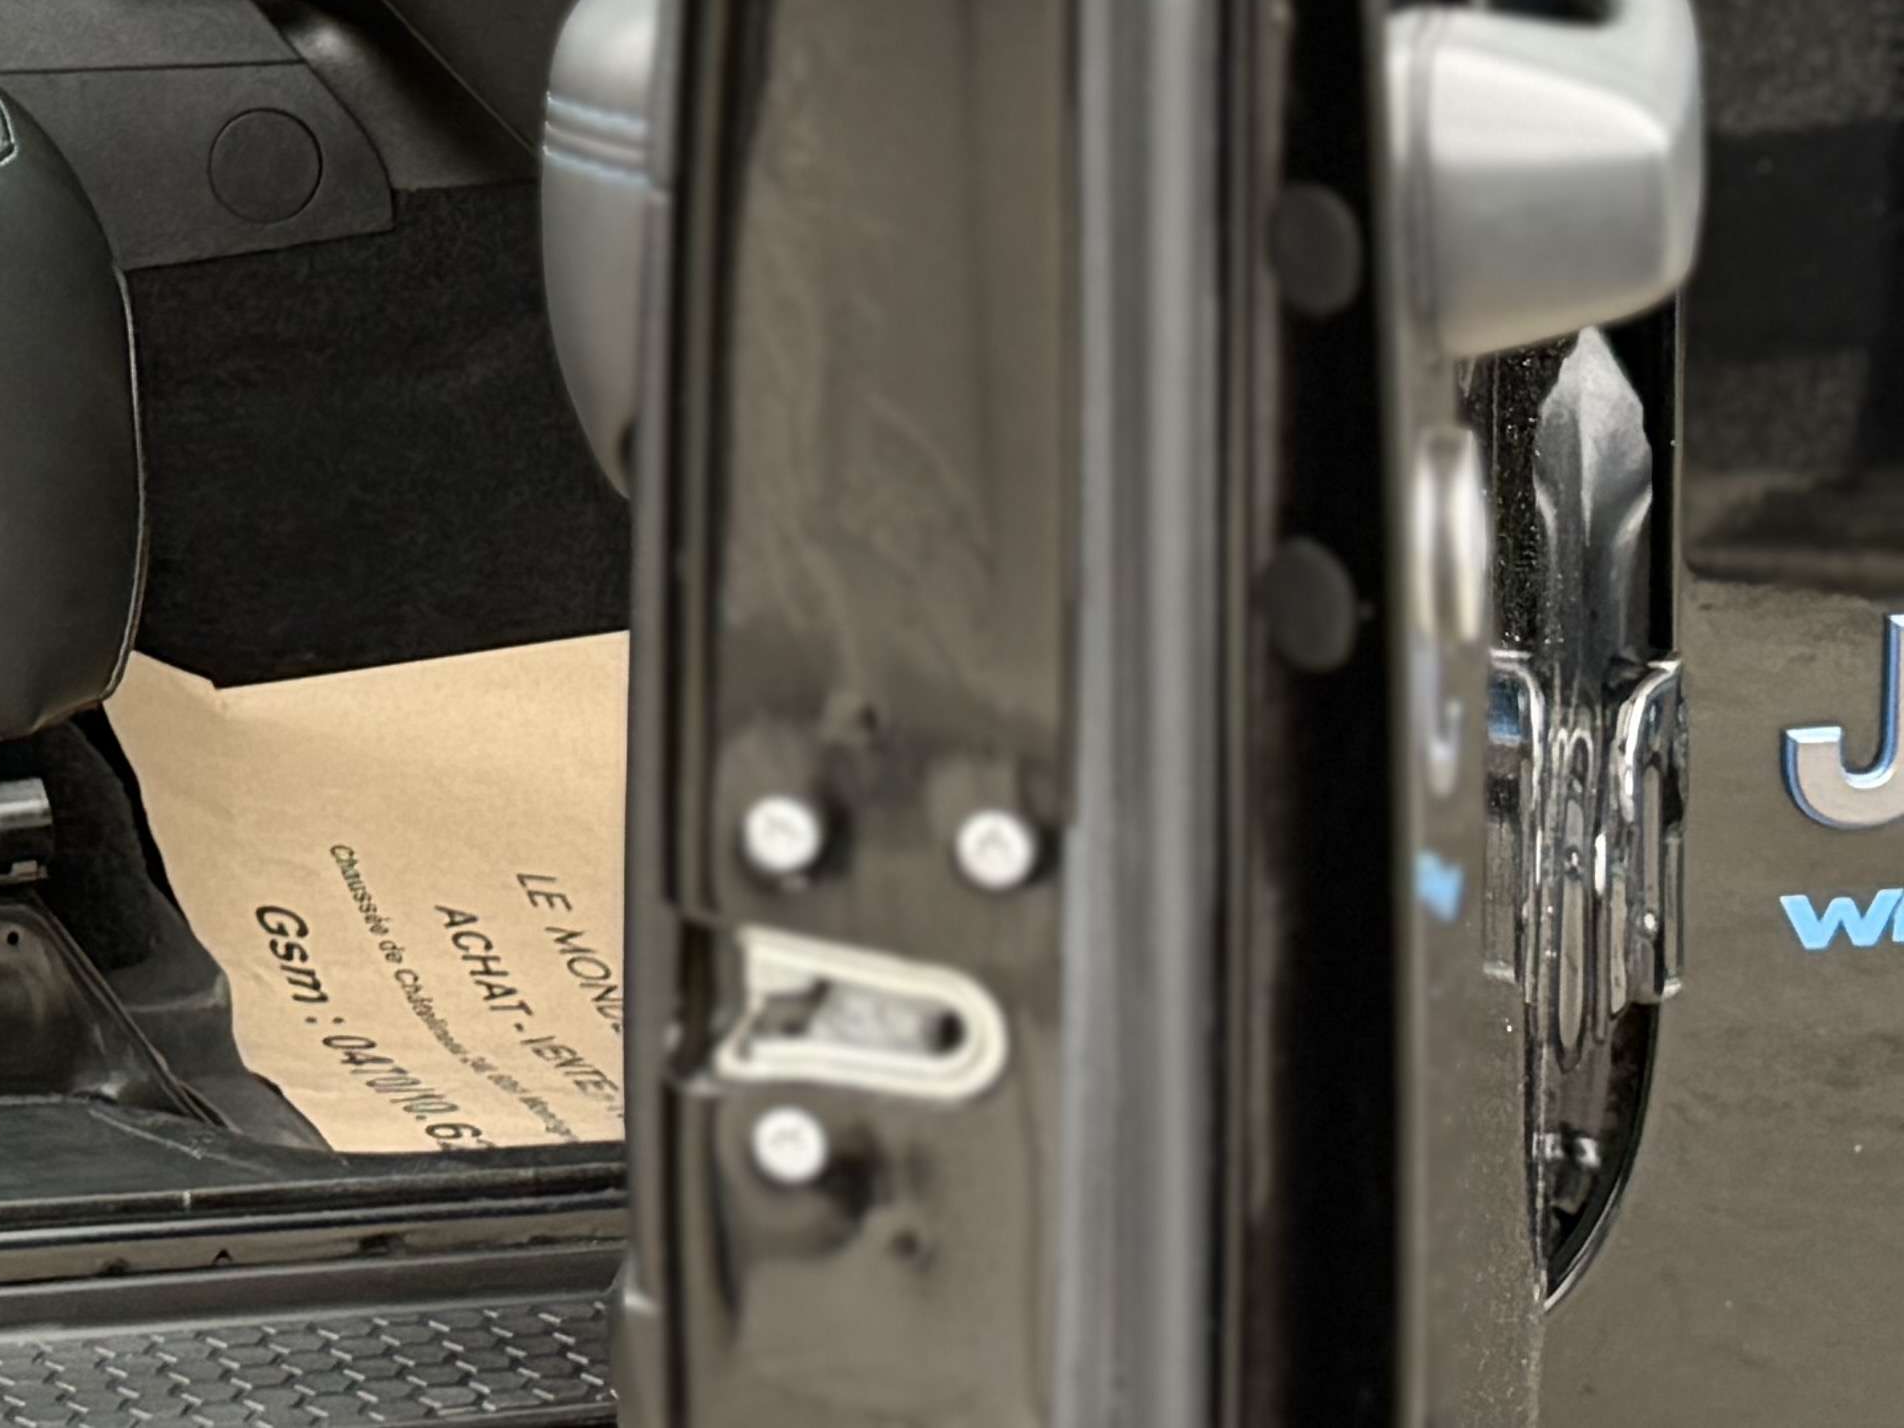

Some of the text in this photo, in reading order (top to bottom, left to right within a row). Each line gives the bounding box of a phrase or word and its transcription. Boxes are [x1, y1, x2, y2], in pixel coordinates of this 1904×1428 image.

[516, 873, 573, 912] LE
[255, 906, 329, 1003] Gsm
[378, 940, 405, 965] de
[434, 904, 534, 1017] ACHAT
[544, 926, 625, 1034] MOND
